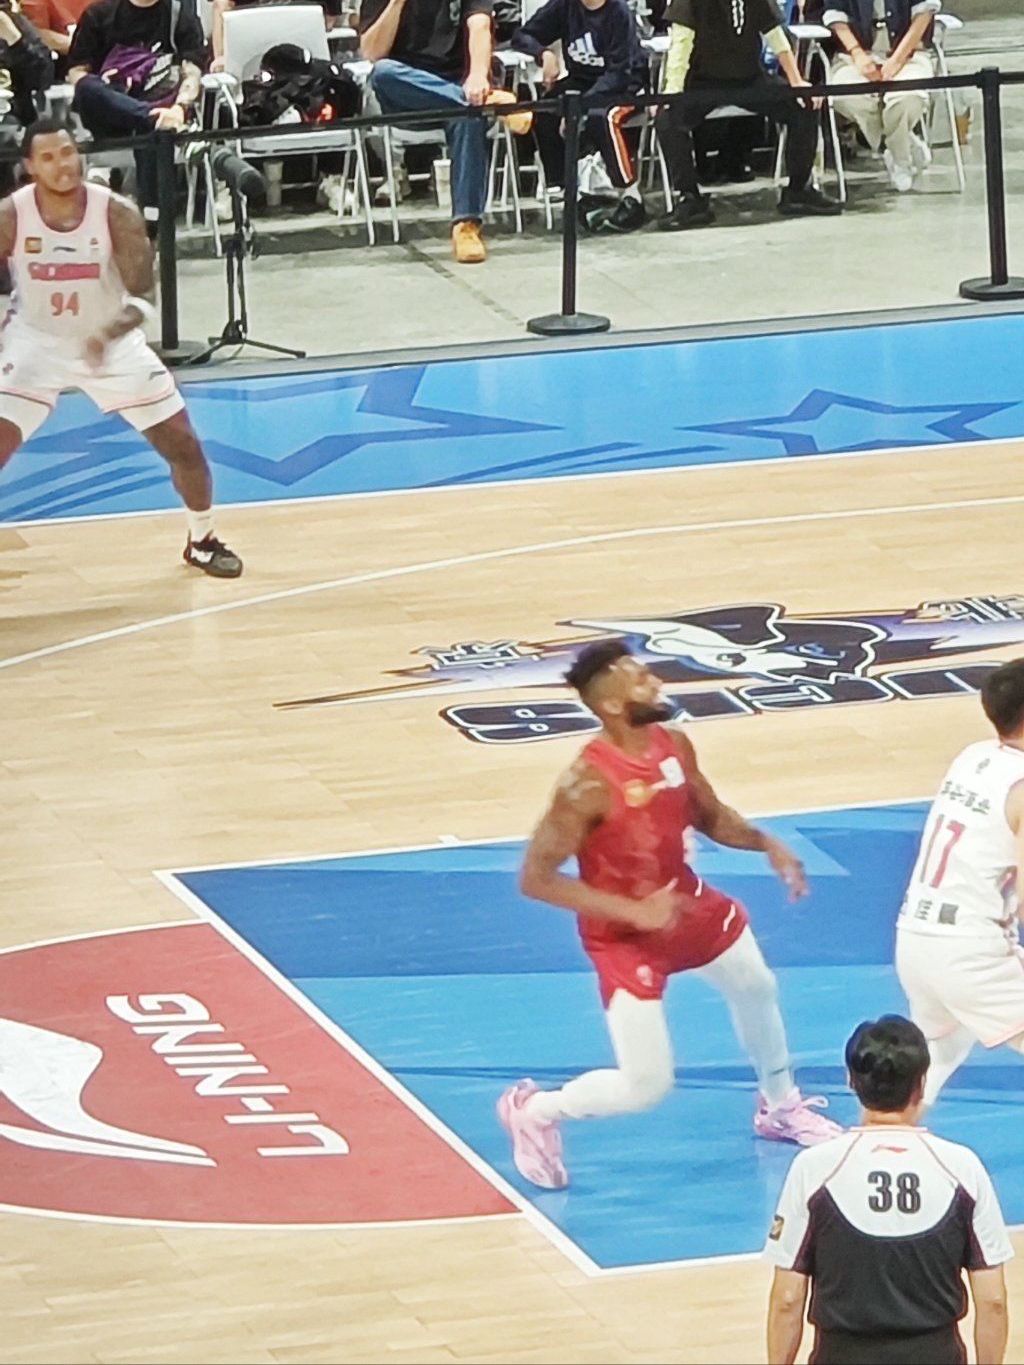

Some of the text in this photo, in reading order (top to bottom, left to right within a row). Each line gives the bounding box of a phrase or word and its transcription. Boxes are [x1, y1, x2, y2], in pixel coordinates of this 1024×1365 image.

[51, 291, 80, 317] 94
[919, 814, 966, 889] 17
[106, 992, 351, 1157] LI-NING
[867, 1170, 921, 1214] 38
